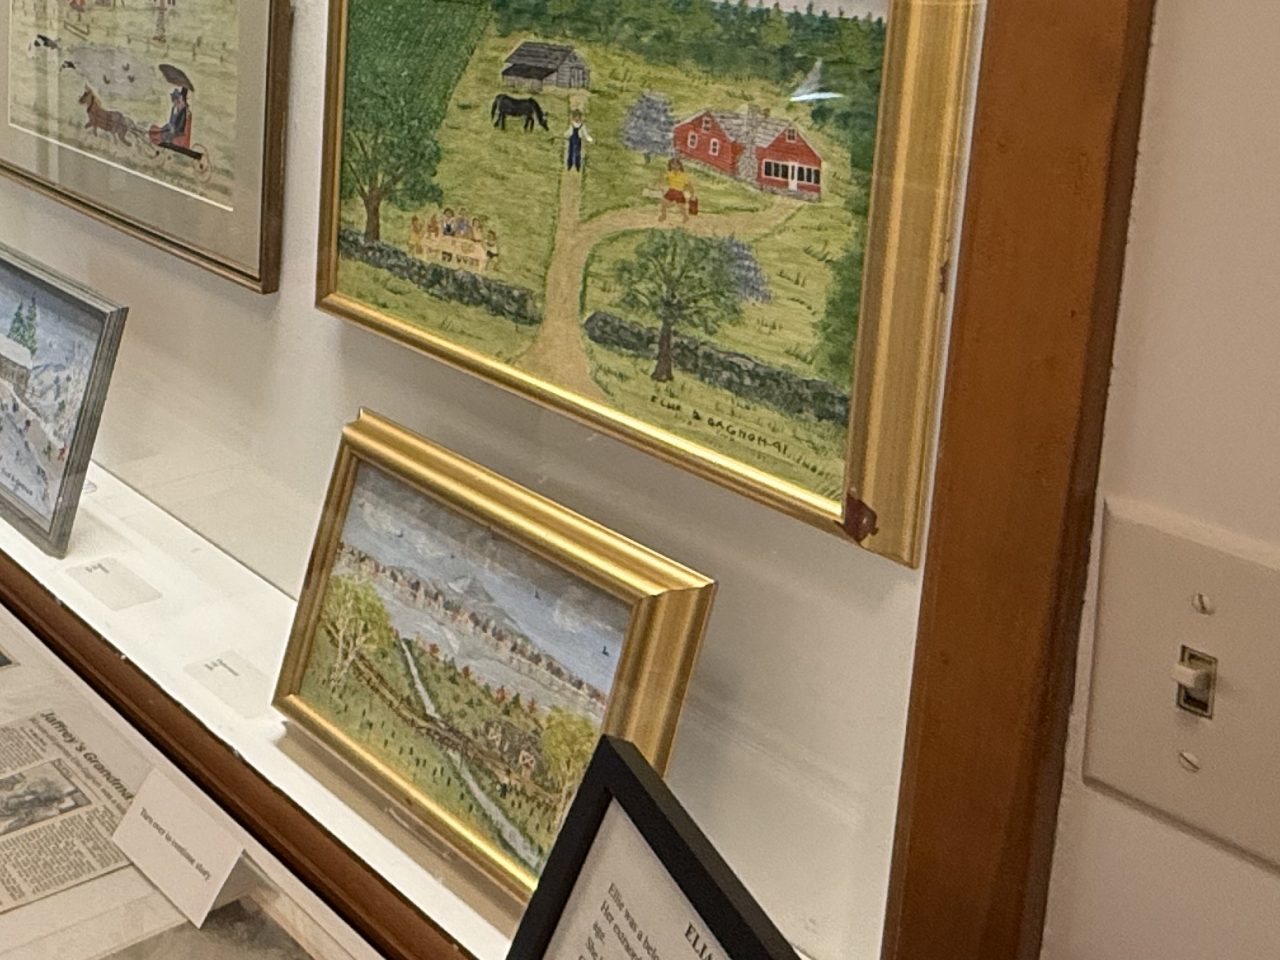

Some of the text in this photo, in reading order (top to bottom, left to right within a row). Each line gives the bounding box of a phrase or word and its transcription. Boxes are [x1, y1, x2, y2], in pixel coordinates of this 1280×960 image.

[83, 752, 135, 801] Grandma
[141, 807, 153, 824] Turn
[152, 822, 166, 836] over
[608, 882, 625, 911] Ellie
[624, 909, 637, 933] was
